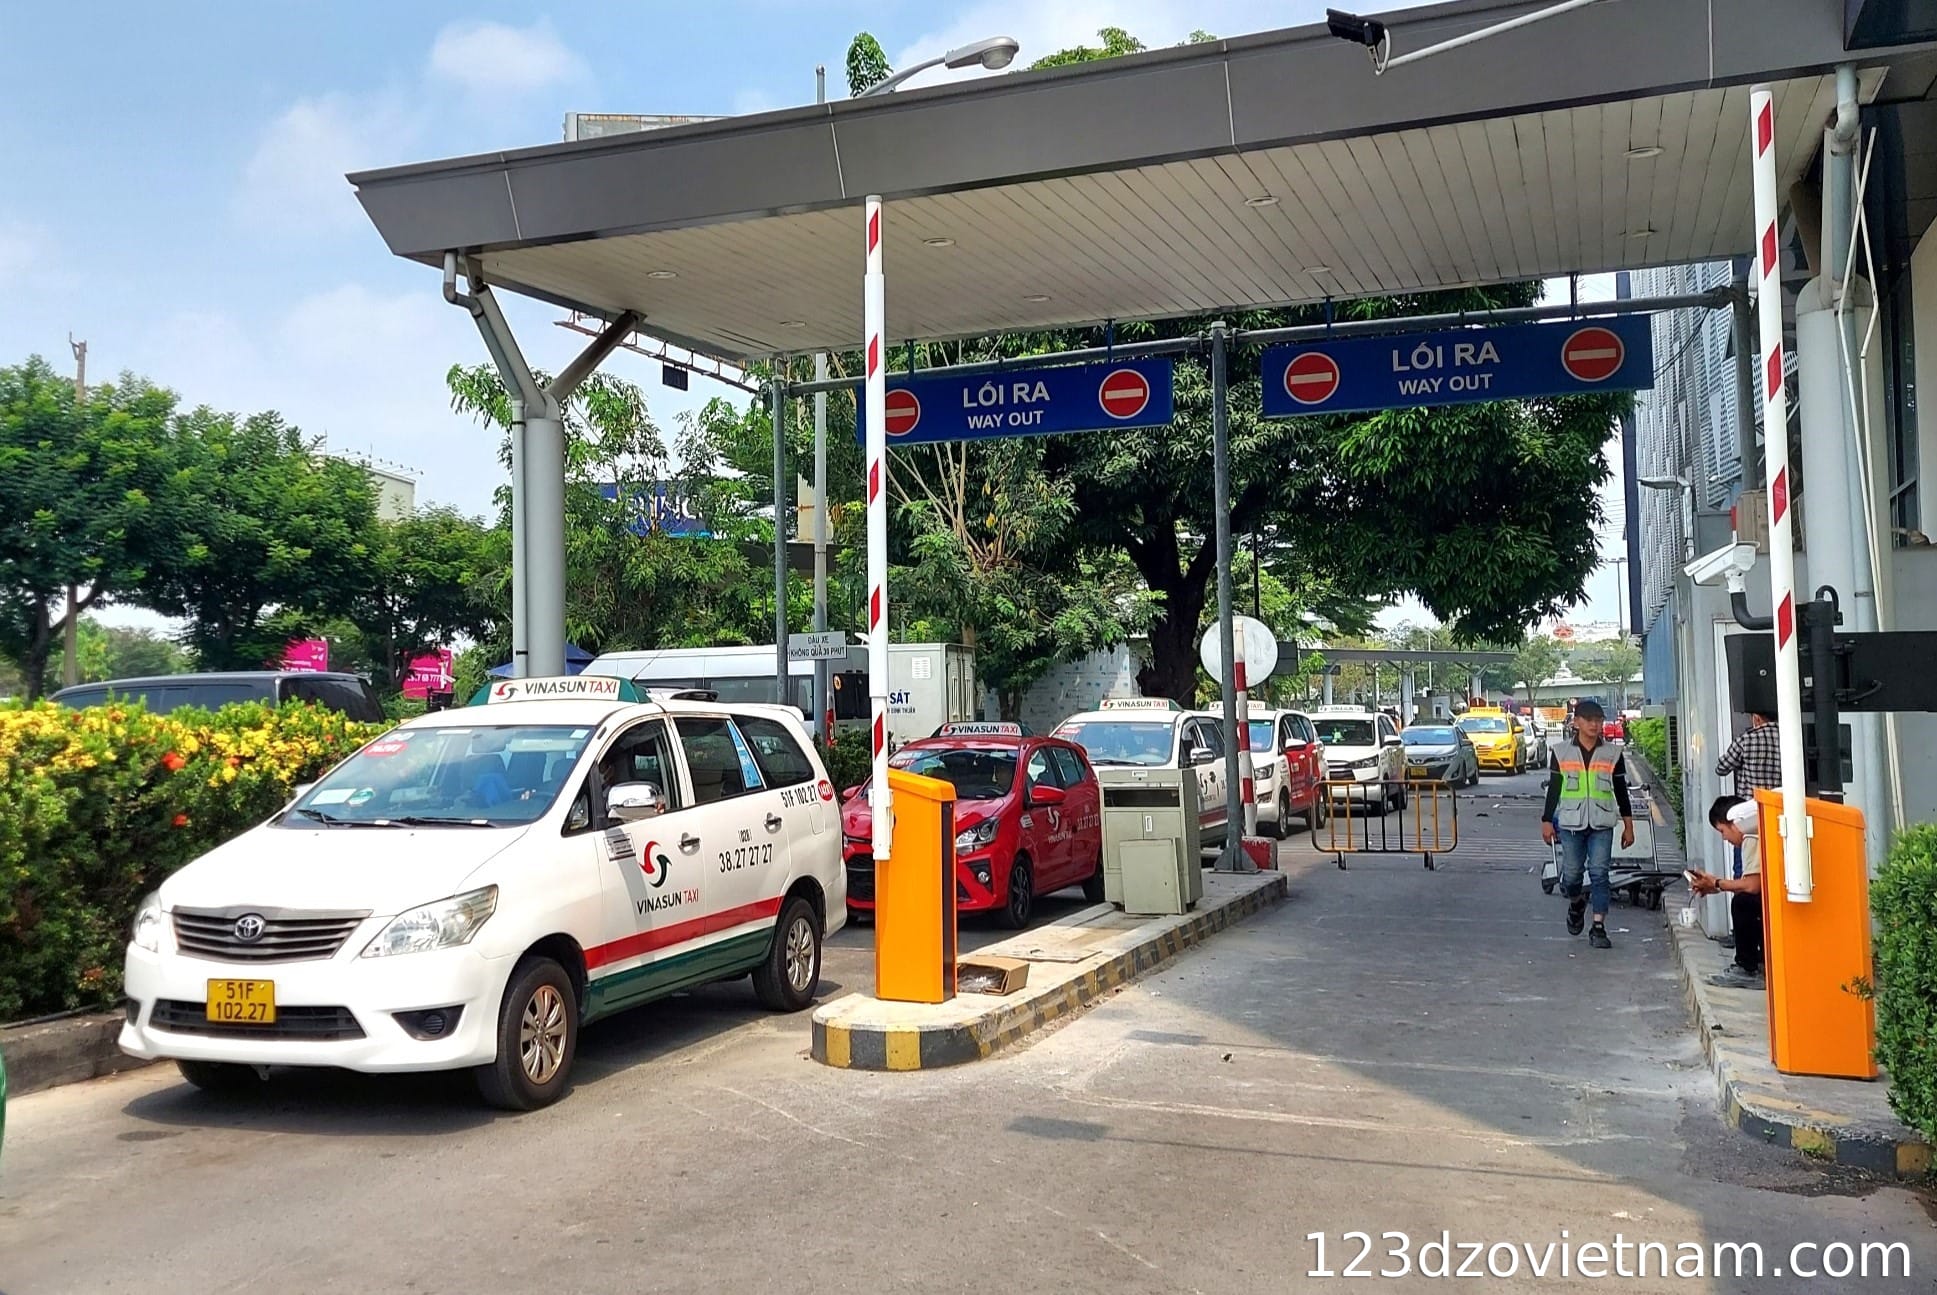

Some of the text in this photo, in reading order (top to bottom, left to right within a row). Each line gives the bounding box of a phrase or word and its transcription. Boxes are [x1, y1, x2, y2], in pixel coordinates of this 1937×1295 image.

[1392, 341, 1500, 371] LỐI RA
[1398, 373, 1493, 395] WAY OUT
[963, 381, 1050, 408] LỐI RA
[967, 410, 1044, 429] WAY OUT
[525, 681, 617, 695] VINASUN TAXI
[889, 688, 911, 705] SÁT
[1117, 700, 1168, 708] VINASUN TAXI
[958, 725, 1018, 734] VINASUN TAXI
[718, 843, 773, 873] 38.27 27 27
[637, 888, 699, 915] VINASUN TAXI
[226, 982, 255, 999] 51F
[216, 1001, 267, 1020] 102.27
